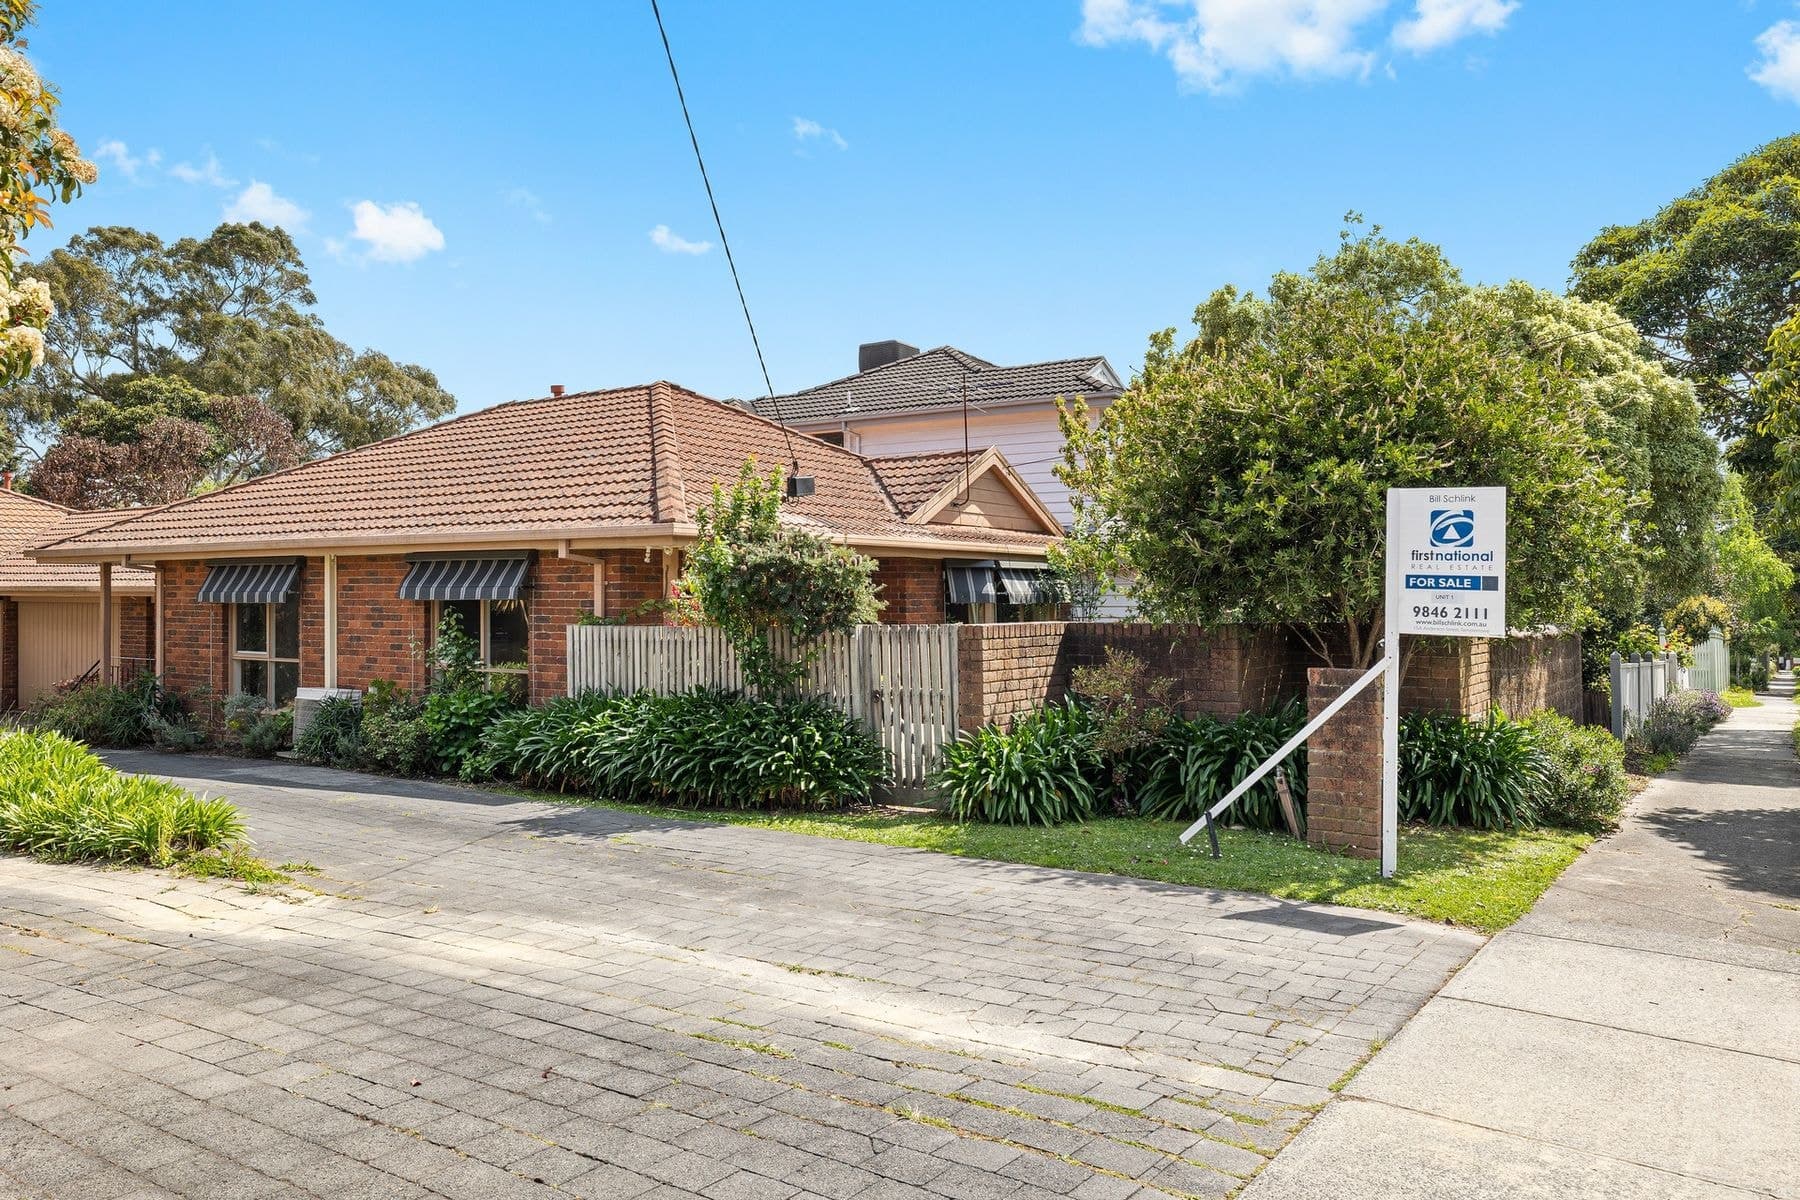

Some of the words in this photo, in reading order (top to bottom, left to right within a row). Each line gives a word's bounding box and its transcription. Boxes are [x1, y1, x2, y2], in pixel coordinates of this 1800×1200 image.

[1429, 494, 1441, 503] Bill
[1443, 494, 1476, 503] Schlink
[1409, 577, 1435, 588] FOR
[1438, 578, 1472, 588] SALE
[1413, 605, 1448, 618] 9846
[1454, 607, 1488, 620] 2111
[1416, 619, 1488, 627] www.billschlink.com.au
